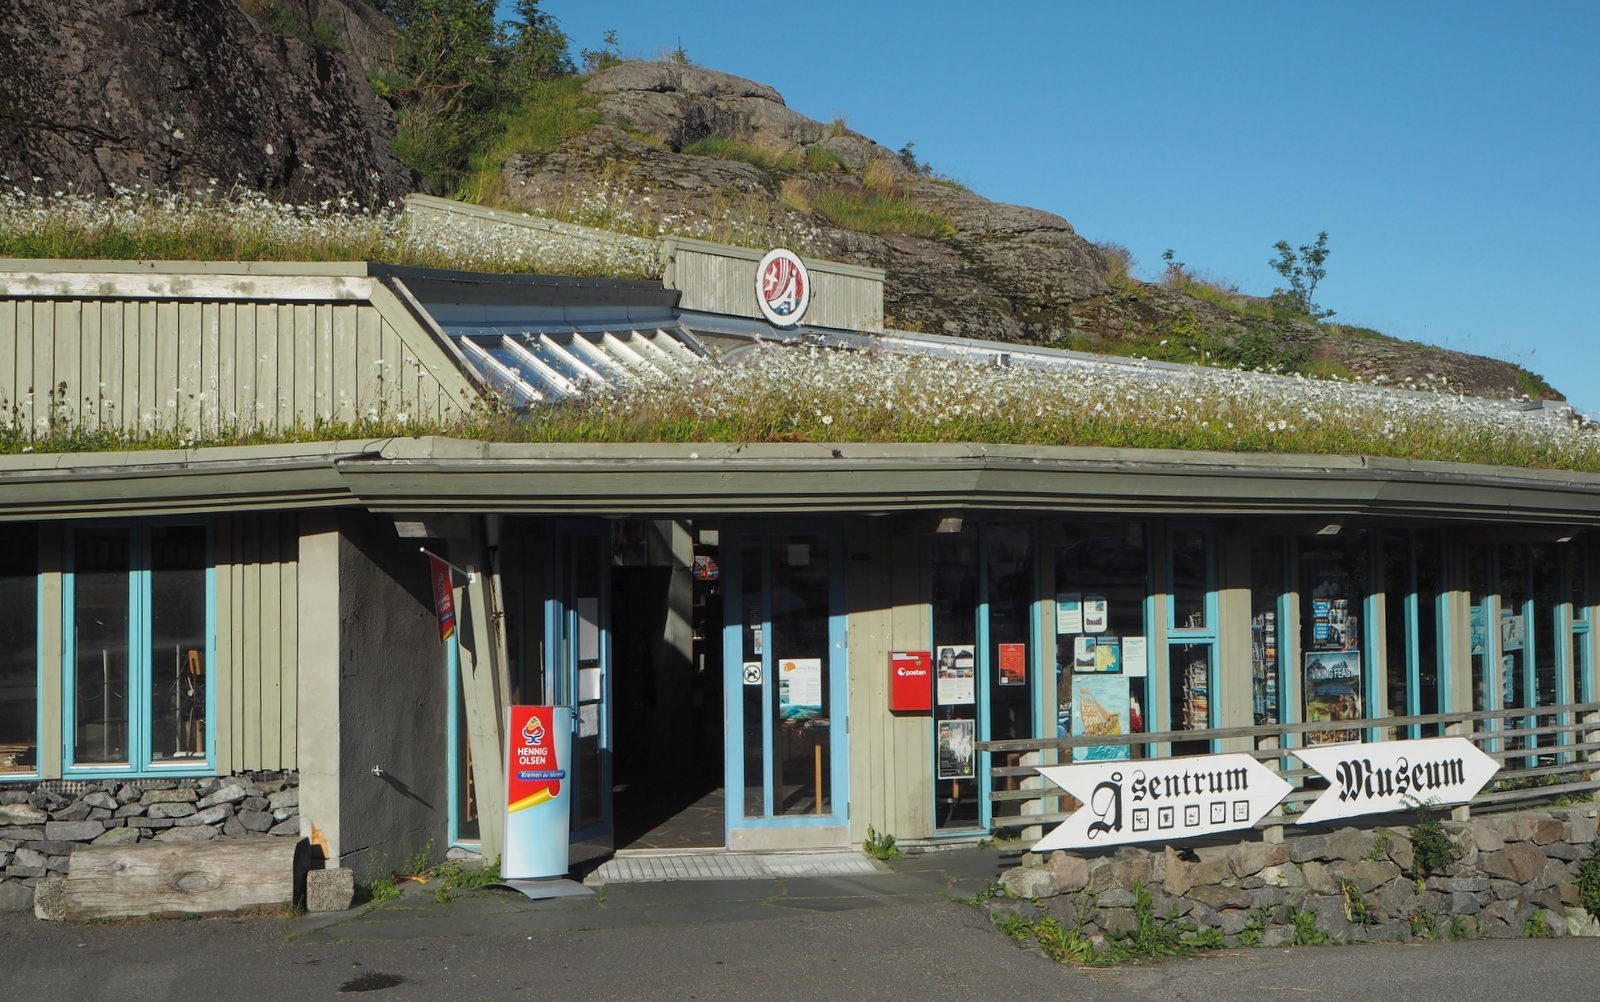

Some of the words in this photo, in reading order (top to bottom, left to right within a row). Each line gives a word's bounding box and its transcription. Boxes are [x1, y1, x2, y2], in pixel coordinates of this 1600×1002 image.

[905, 669, 927, 677] posten
[1311, 668, 1334, 680] VIKING
[517, 747, 548, 756] HENNIG
[519, 756, 546, 765] OLSEN
[1336, 756, 1466, 803] Museum
[1087, 771, 1123, 840] Å
